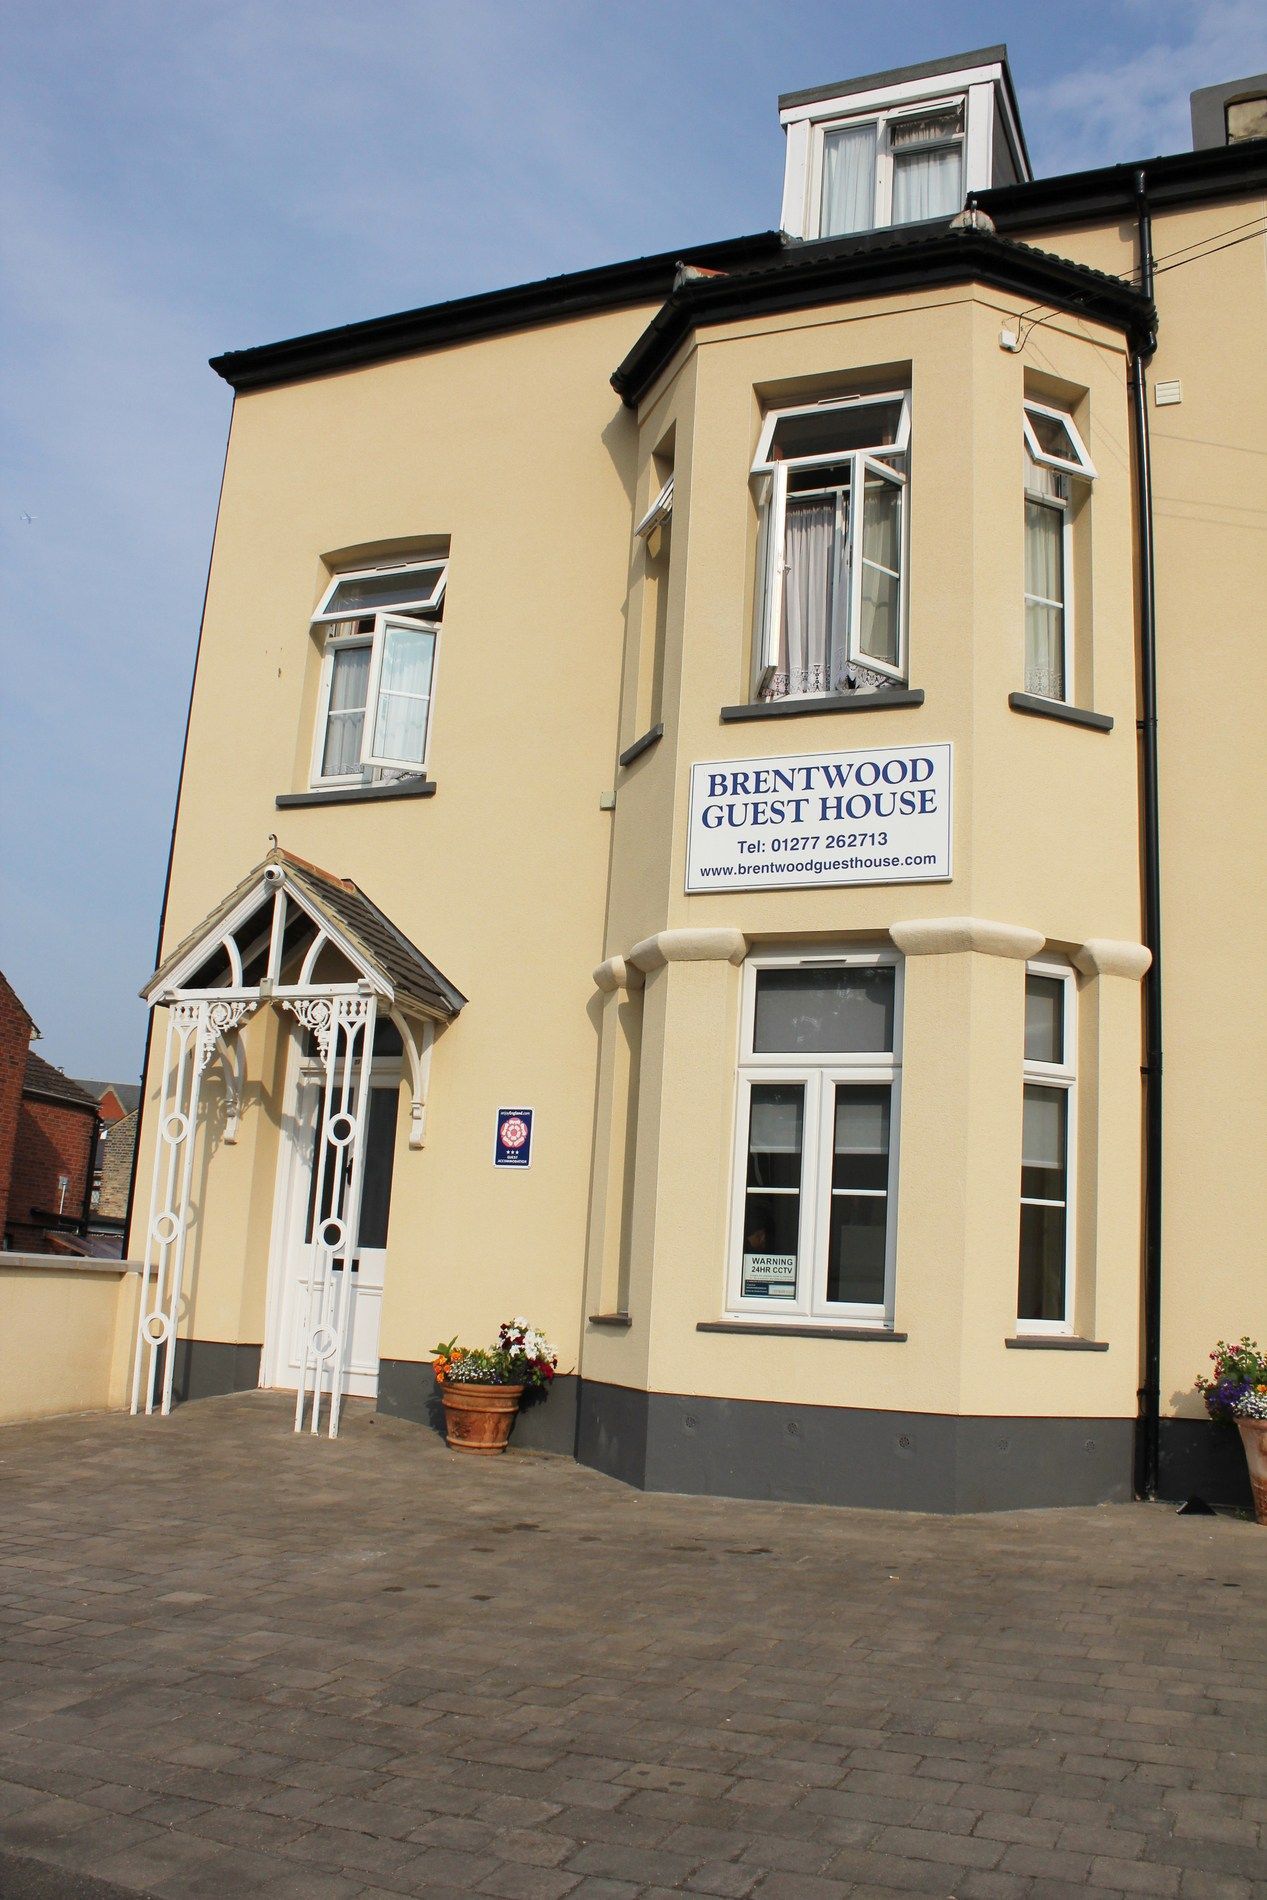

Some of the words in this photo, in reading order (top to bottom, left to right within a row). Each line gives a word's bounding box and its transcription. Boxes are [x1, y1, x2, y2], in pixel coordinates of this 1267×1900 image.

[707, 757, 934, 798] BRENTWOOD
[701, 798, 809, 829] GUEST
[819, 789, 938, 822] HOUSE
[737, 840, 766, 854] Tel:
[771, 836, 820, 852] 01277
[825, 832, 888, 849] 262713
[700, 853, 937, 877] www.brentwoodguesthouse.com
